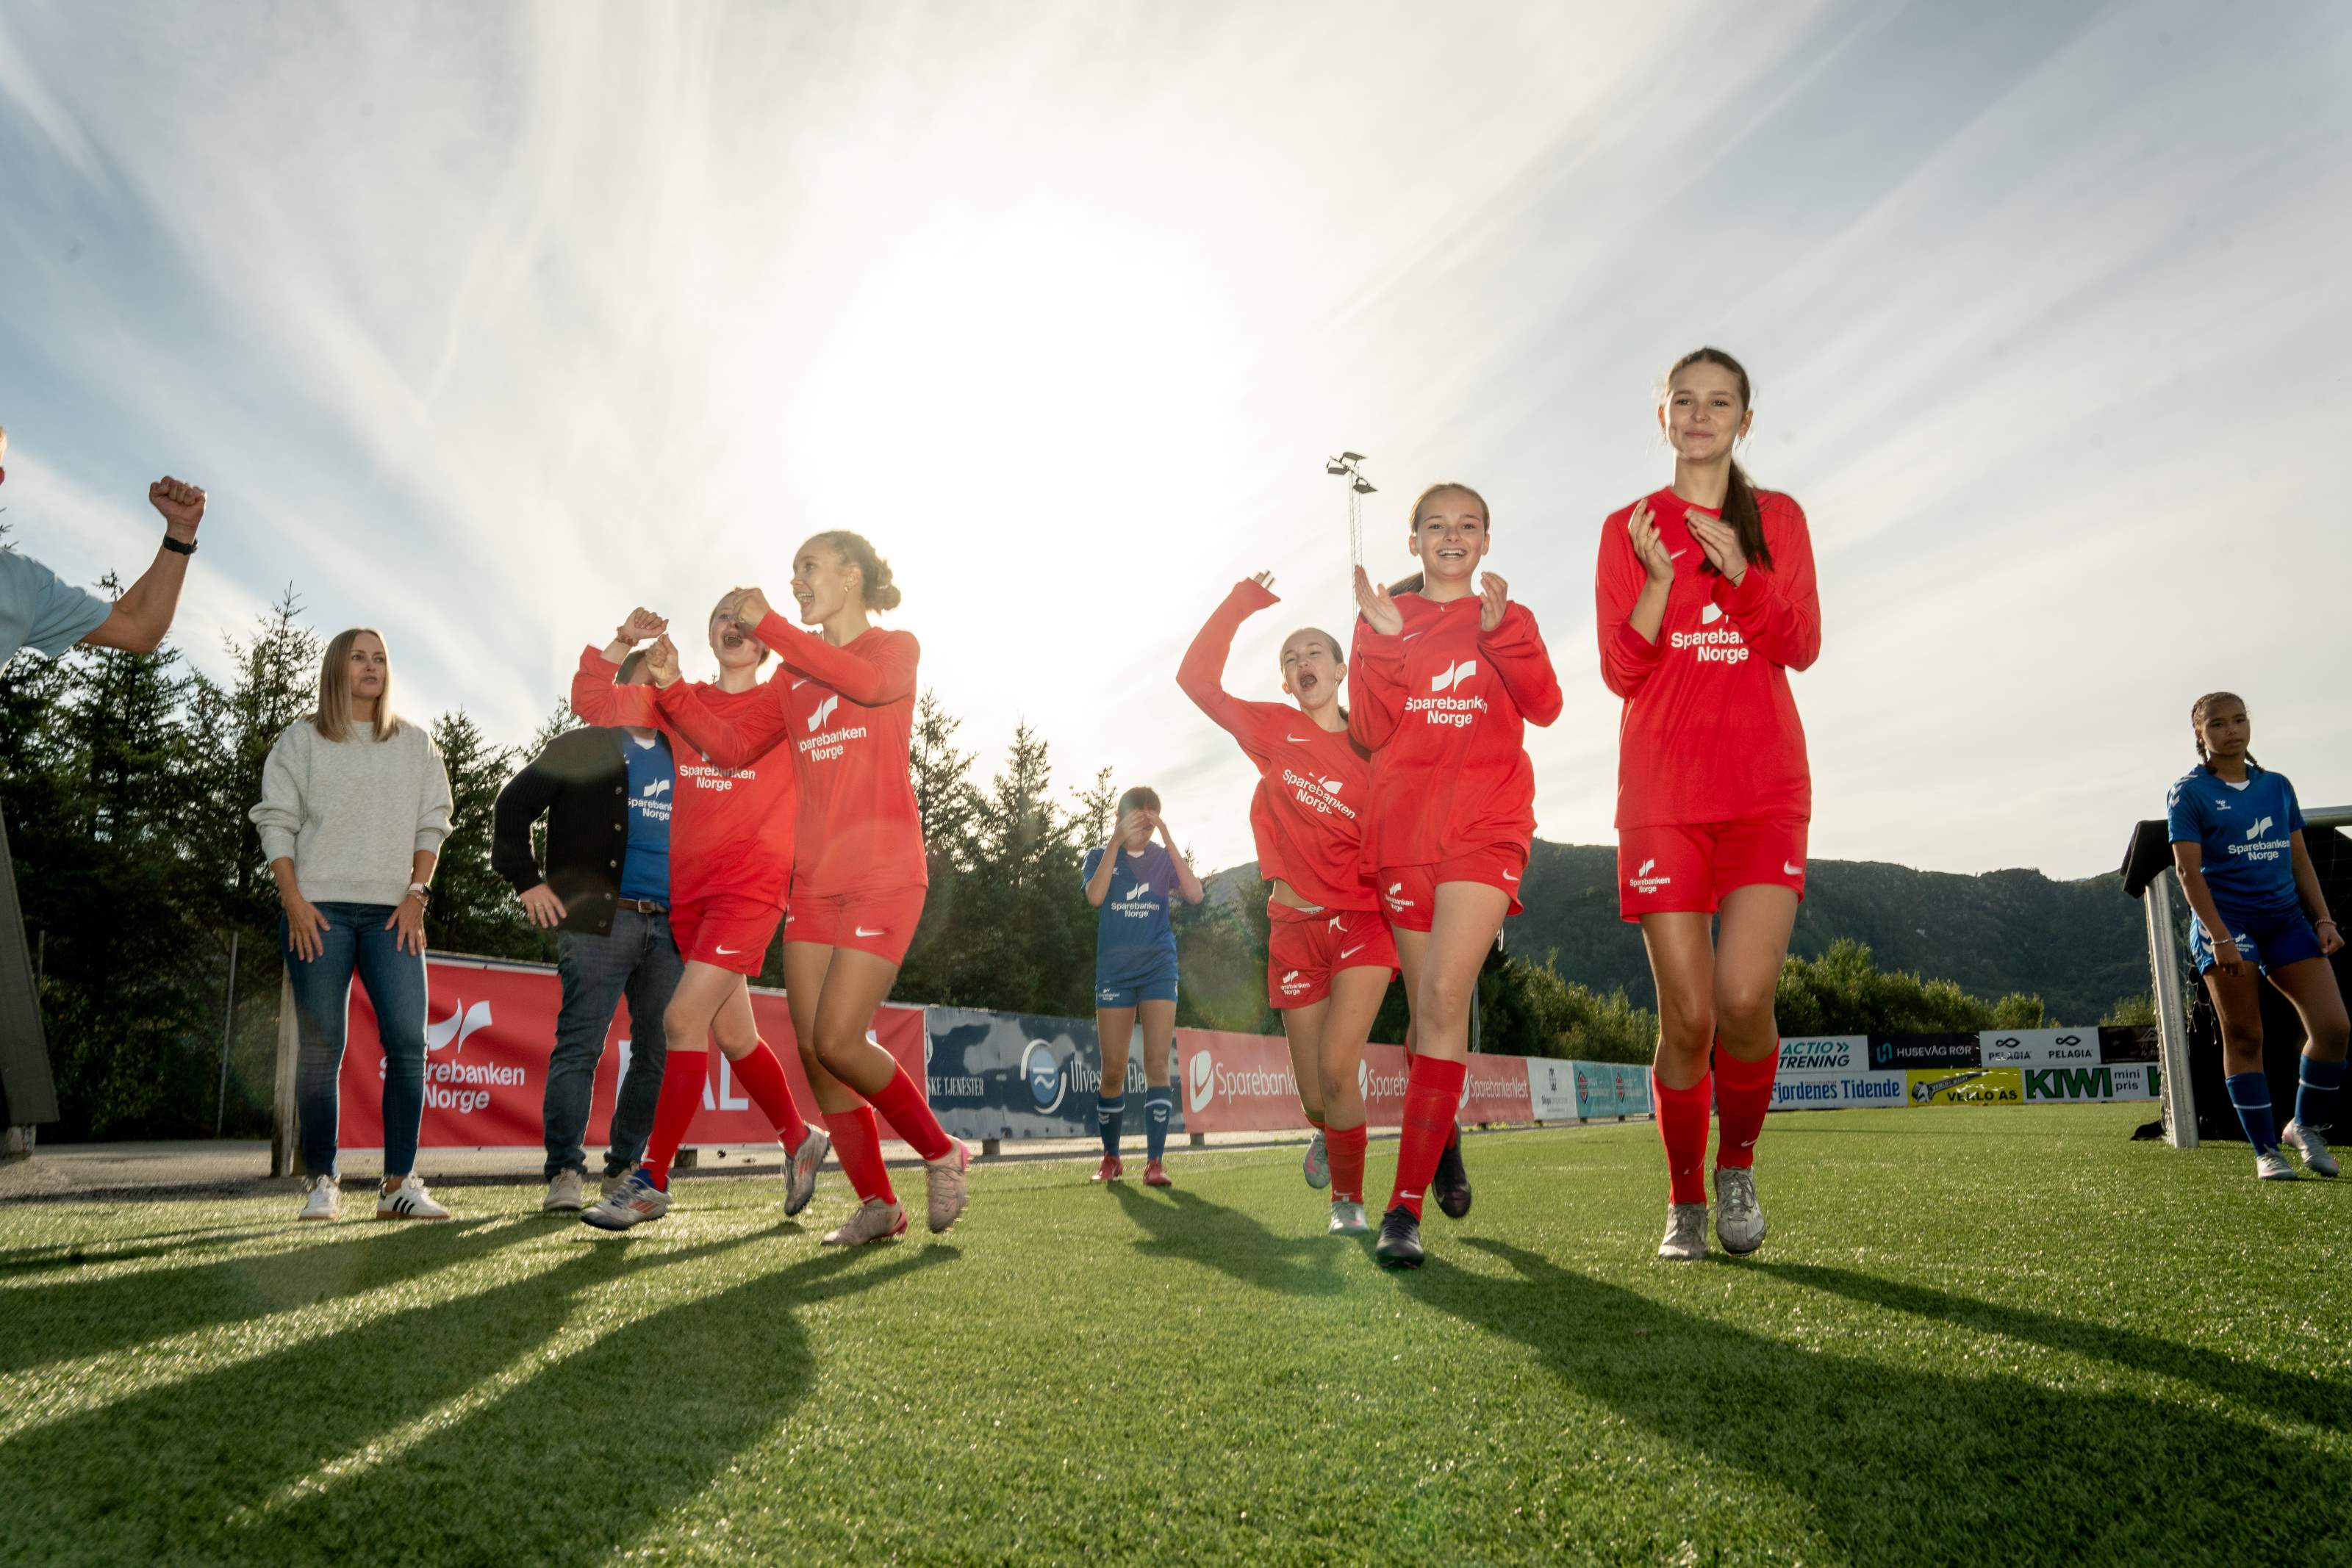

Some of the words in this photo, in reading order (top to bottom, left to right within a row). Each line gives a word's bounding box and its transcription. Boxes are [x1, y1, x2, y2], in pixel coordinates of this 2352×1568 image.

[1697, 645, 1749, 665] Norge
[1427, 710, 1473, 728] Norge
[797, 727, 867, 754] parebanken
[811, 745, 844, 763] Norge
[696, 776, 733, 792] Norge
[1282, 769, 1356, 819] Sparebanken
[642, 808, 670, 821] Norge
[2228, 838, 2291, 855] Sparebanken
[2247, 850, 2279, 861] Norge
[1629, 877, 1671, 888] Sparebanken
[1638, 885, 1657, 894] Norge
[1111, 901, 1160, 912] Sparebanken
[1125, 910, 1148, 918] Norge
[1782, 1041, 1835, 1055] ACTIO
[1897, 1046, 1947, 1057] HUSEVÅG
[1949, 1045, 1972, 1055] RØR
[1988, 1051, 2031, 1060] PELAGIA
[2048, 1049, 2093, 1059] PELAGIA
[1779, 1054, 1850, 1069] TRENING
[943, 1076, 983, 1096] TJENESTER
[1216, 1061, 1299, 1105] Sparebank
[1840, 1078, 1900, 1098] Tidende
[2025, 1067, 2113, 1099] KIWI
[2114, 1069, 2140, 1079] mini
[2115, 1079, 2139, 1091] pris
[423, 1083, 490, 1115] Norge
[1998, 1090, 2018, 1101] AS
